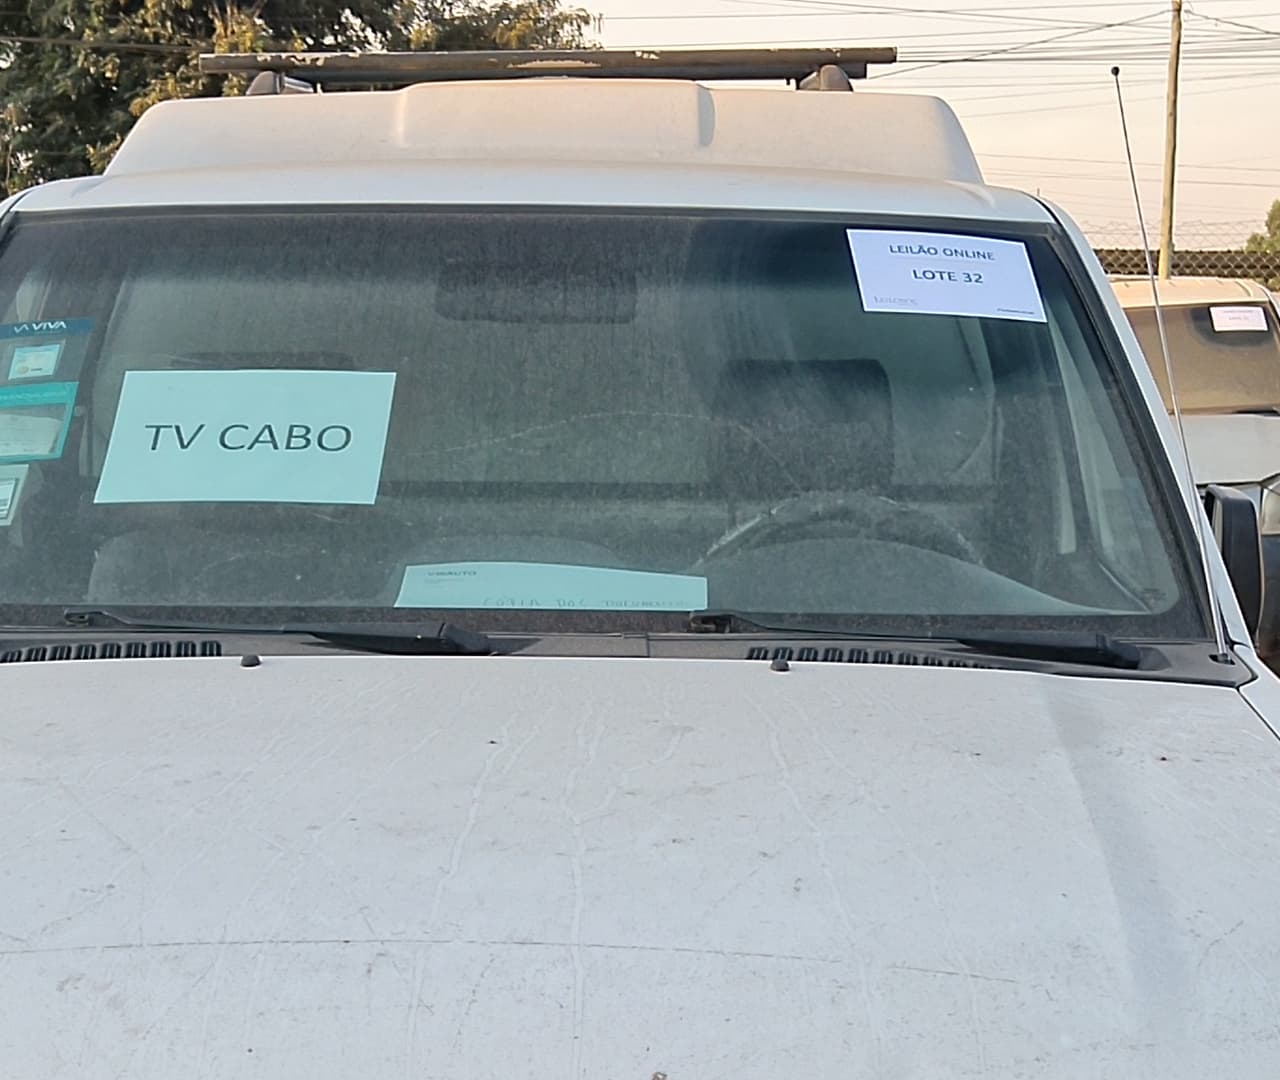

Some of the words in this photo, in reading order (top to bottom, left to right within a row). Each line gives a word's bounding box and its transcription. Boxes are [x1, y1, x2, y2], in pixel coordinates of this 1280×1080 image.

[889, 243, 939, 256] LEILÃO
[942, 248, 996, 261] ONLINE
[912, 269, 958, 282] LOTE
[962, 272, 984, 284] 32
[32, 320, 68, 331] VIVA
[144, 424, 206, 451] TV
[218, 424, 353, 452] CABO
